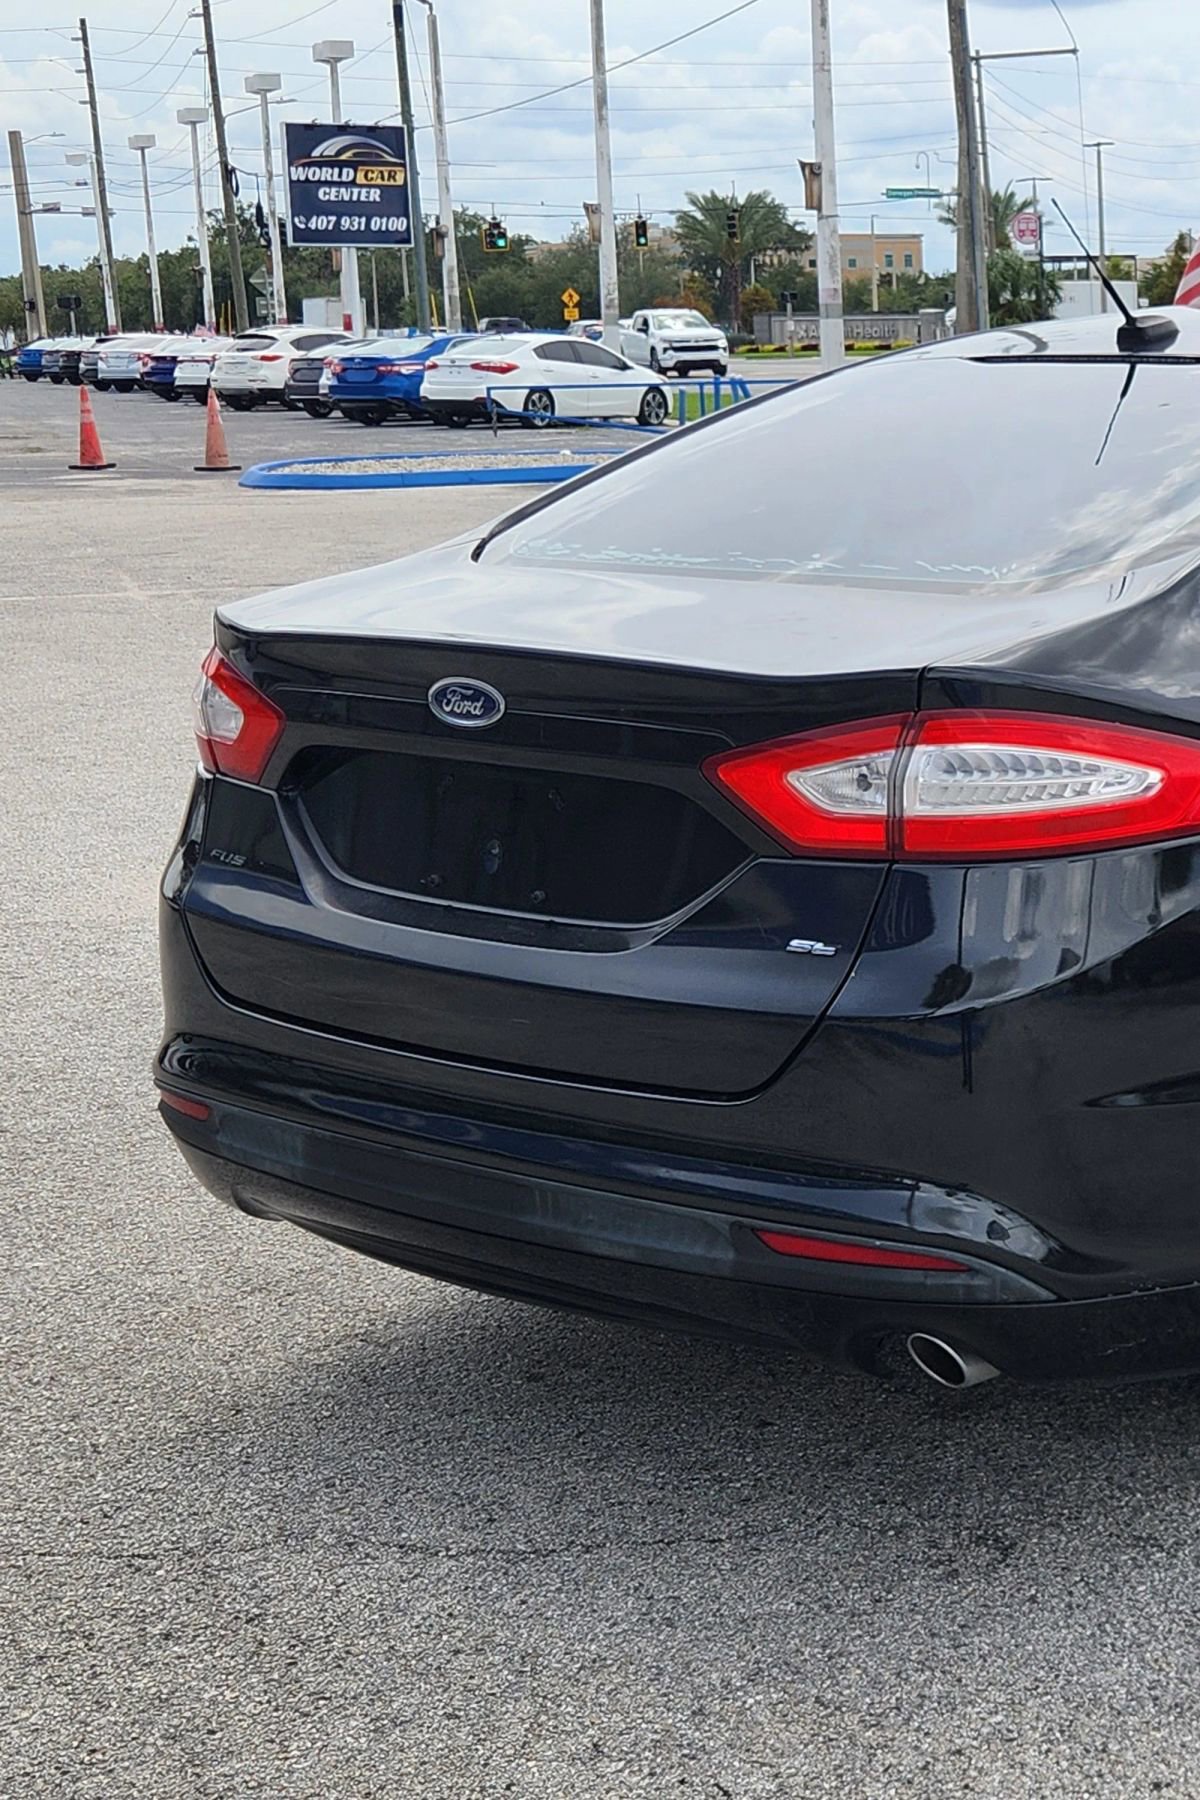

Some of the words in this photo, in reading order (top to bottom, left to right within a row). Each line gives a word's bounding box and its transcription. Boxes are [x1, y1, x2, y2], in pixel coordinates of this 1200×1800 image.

[290, 166, 355, 182] WORLD
[363, 169, 398, 182] CAR
[318, 187, 381, 202] CENTER
[308, 216, 337, 230] 407
[340, 216, 366, 231] 931
[370, 216, 407, 231] 0100
[442, 687, 485, 716] Ford
[210, 849, 247, 866] FUS
[786, 939, 836, 956] SE
